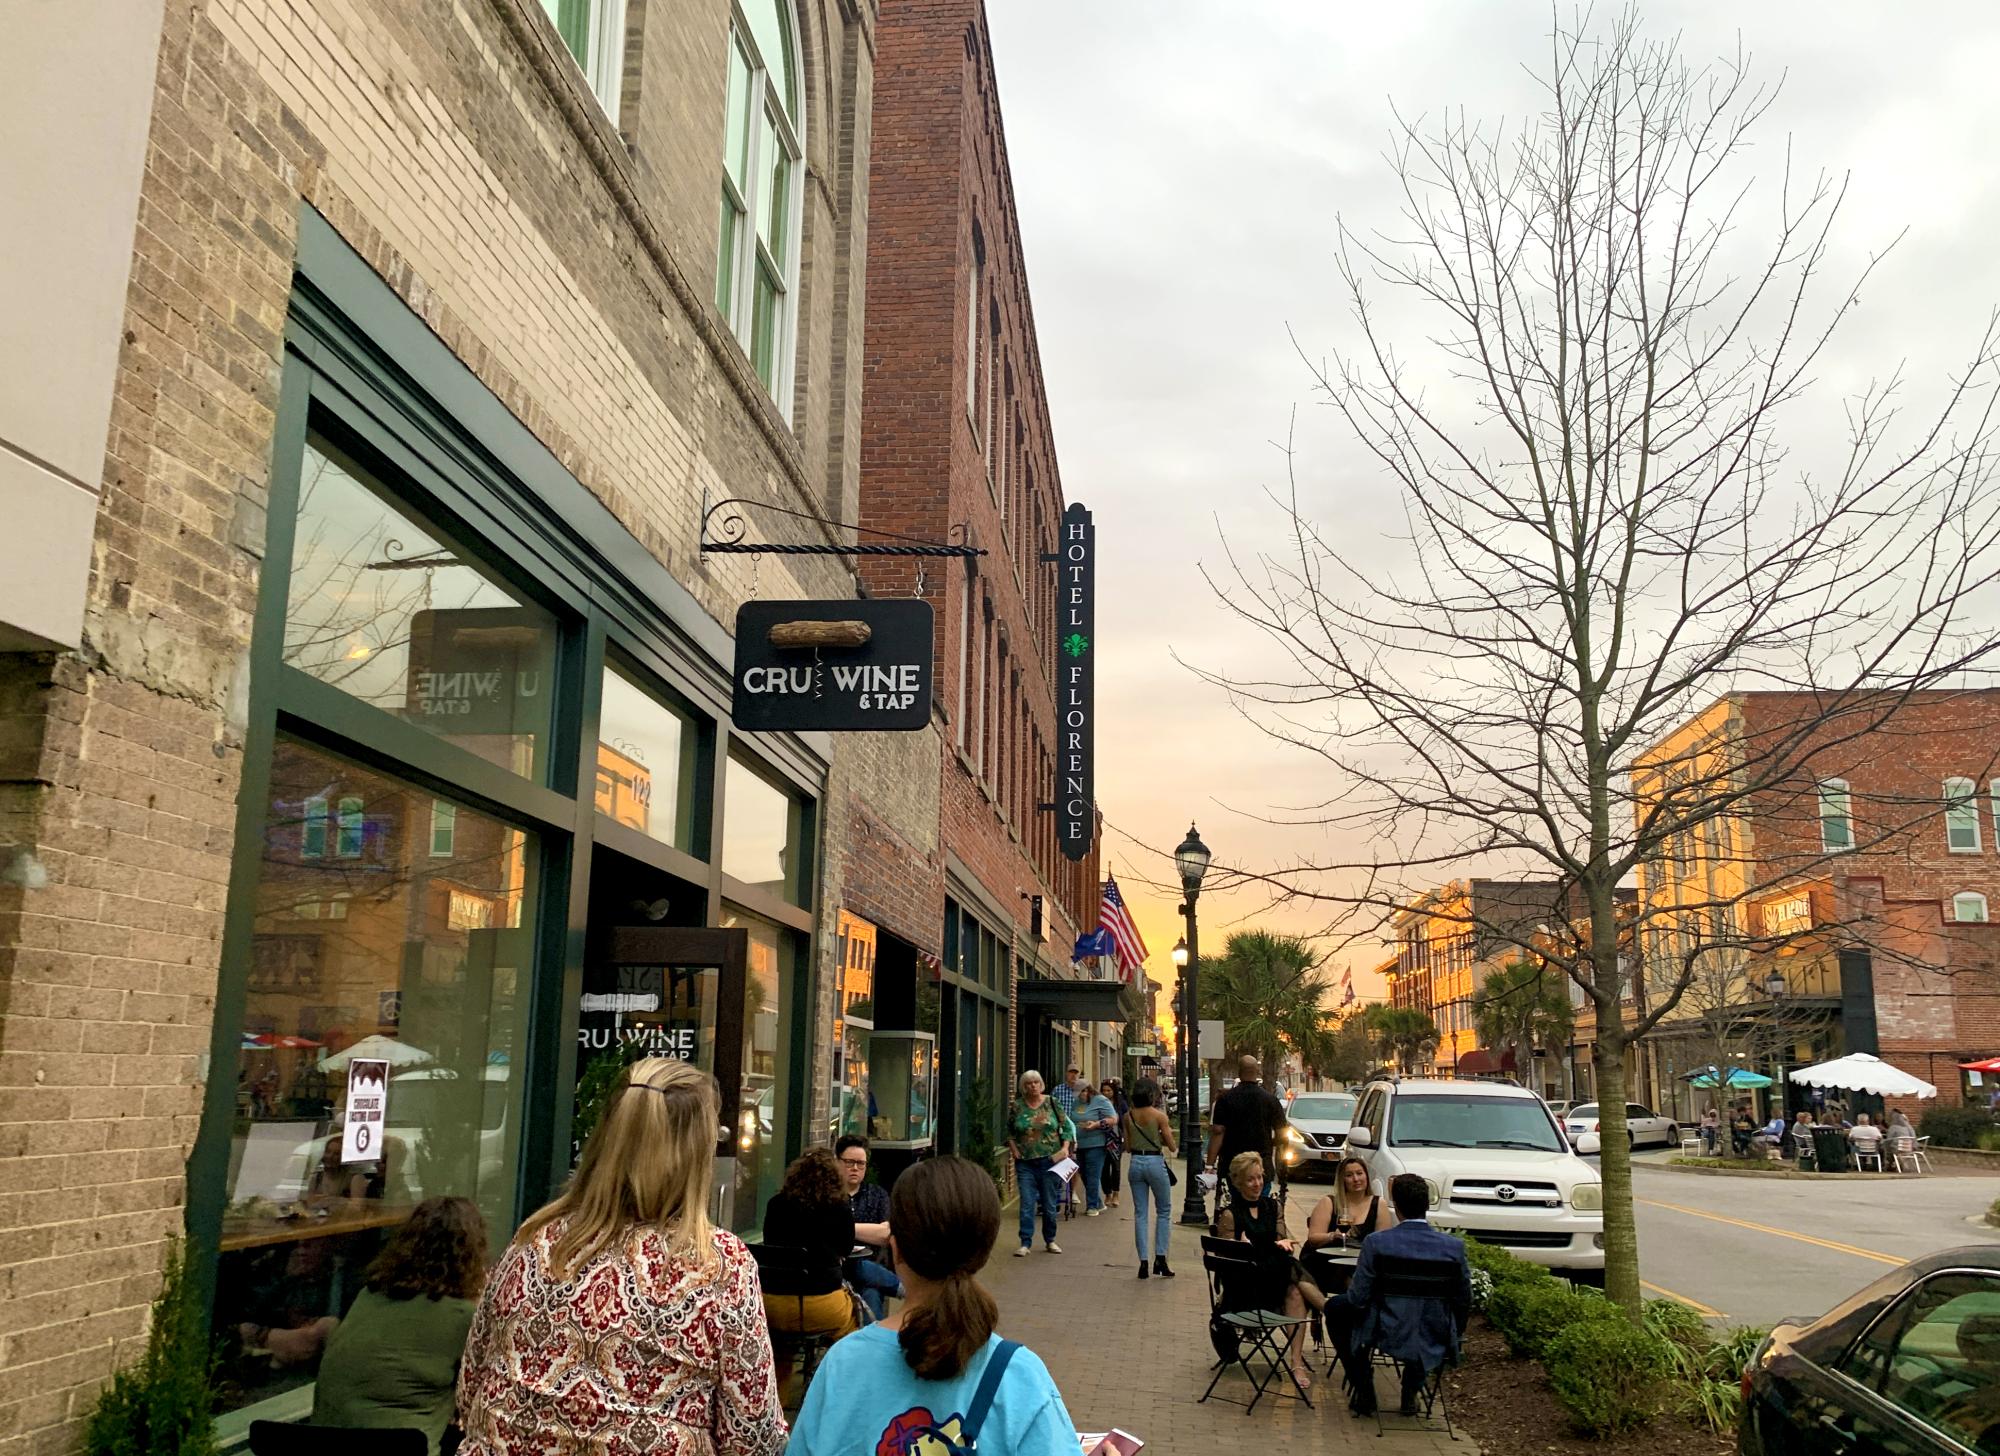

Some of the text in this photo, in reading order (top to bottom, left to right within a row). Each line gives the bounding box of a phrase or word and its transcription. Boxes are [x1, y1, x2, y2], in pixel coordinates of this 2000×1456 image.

[743, 665, 920, 693] CRU WINE
[1066, 523, 1085, 839] HOTEL FLORENCE
[859, 693, 915, 710] & TAP
[633, 774, 651, 809] 122
[578, 1028, 695, 1049] RU WINE
[357, 1128, 368, 1150] 6
